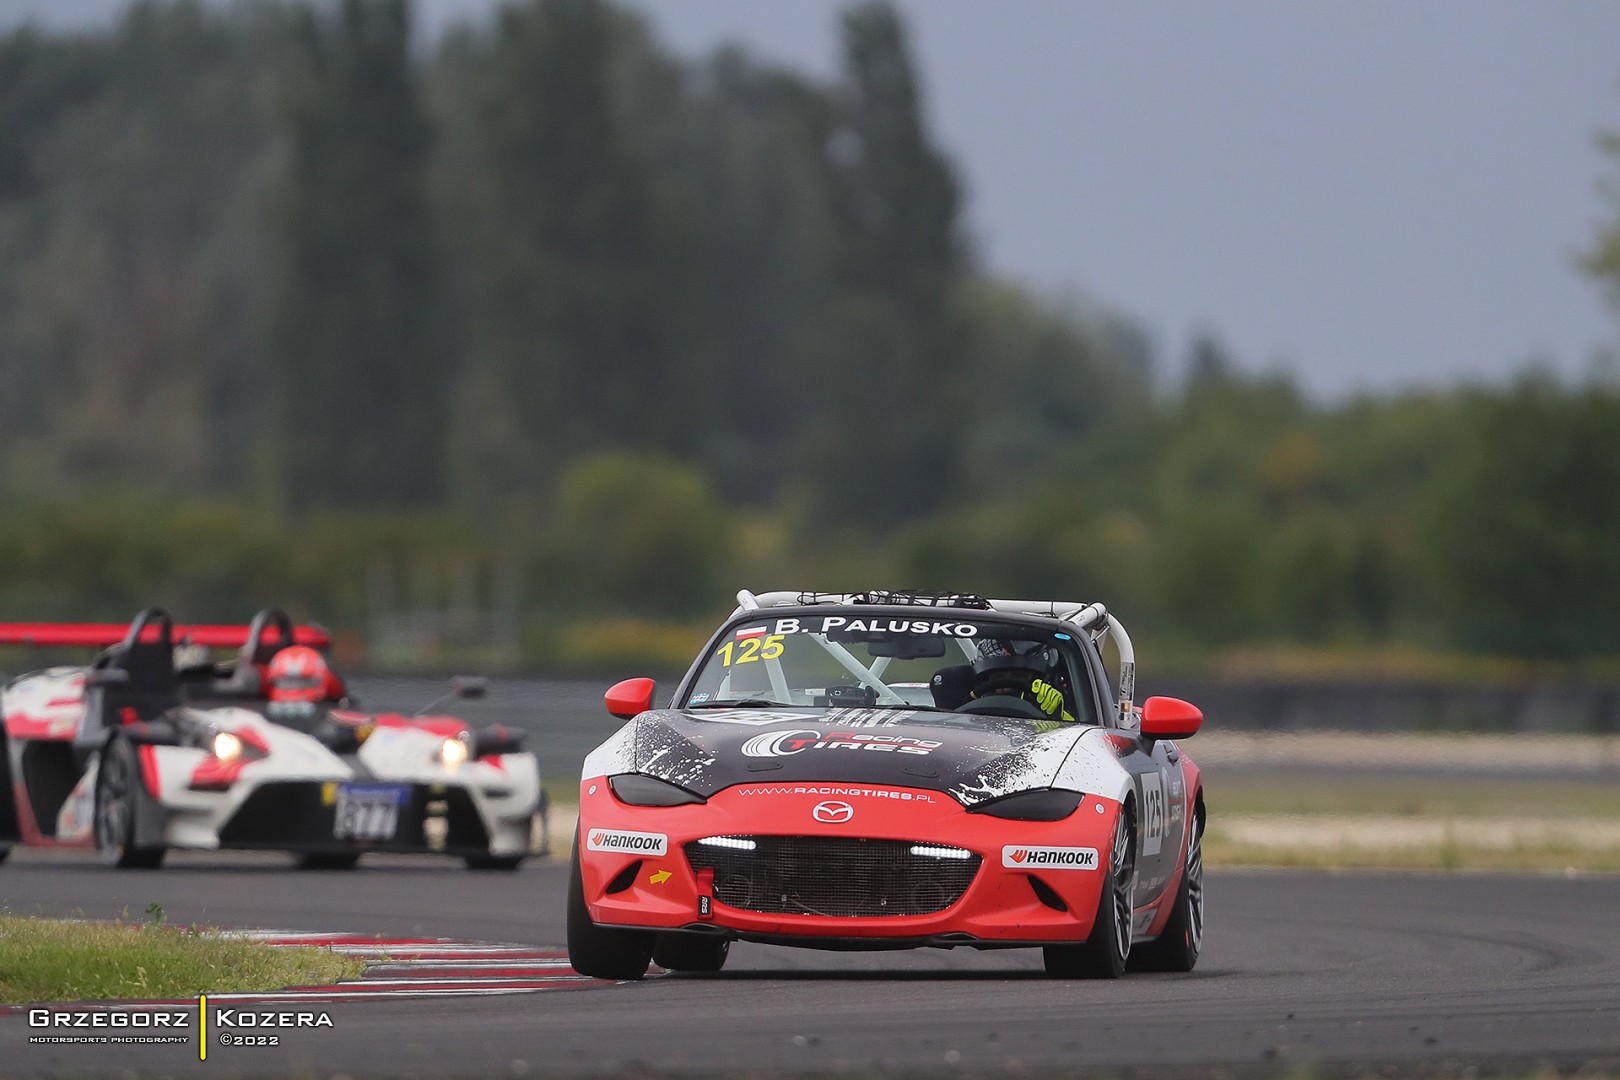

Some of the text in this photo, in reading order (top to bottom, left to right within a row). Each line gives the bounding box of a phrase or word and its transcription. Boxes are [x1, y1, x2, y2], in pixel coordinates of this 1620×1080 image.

[775, 616, 978, 637] B. PALUSKO
[717, 634, 785, 667] 125
[738, 787, 936, 804] WWW.RACINGTIRES.PL
[1146, 790, 1161, 837] 125
